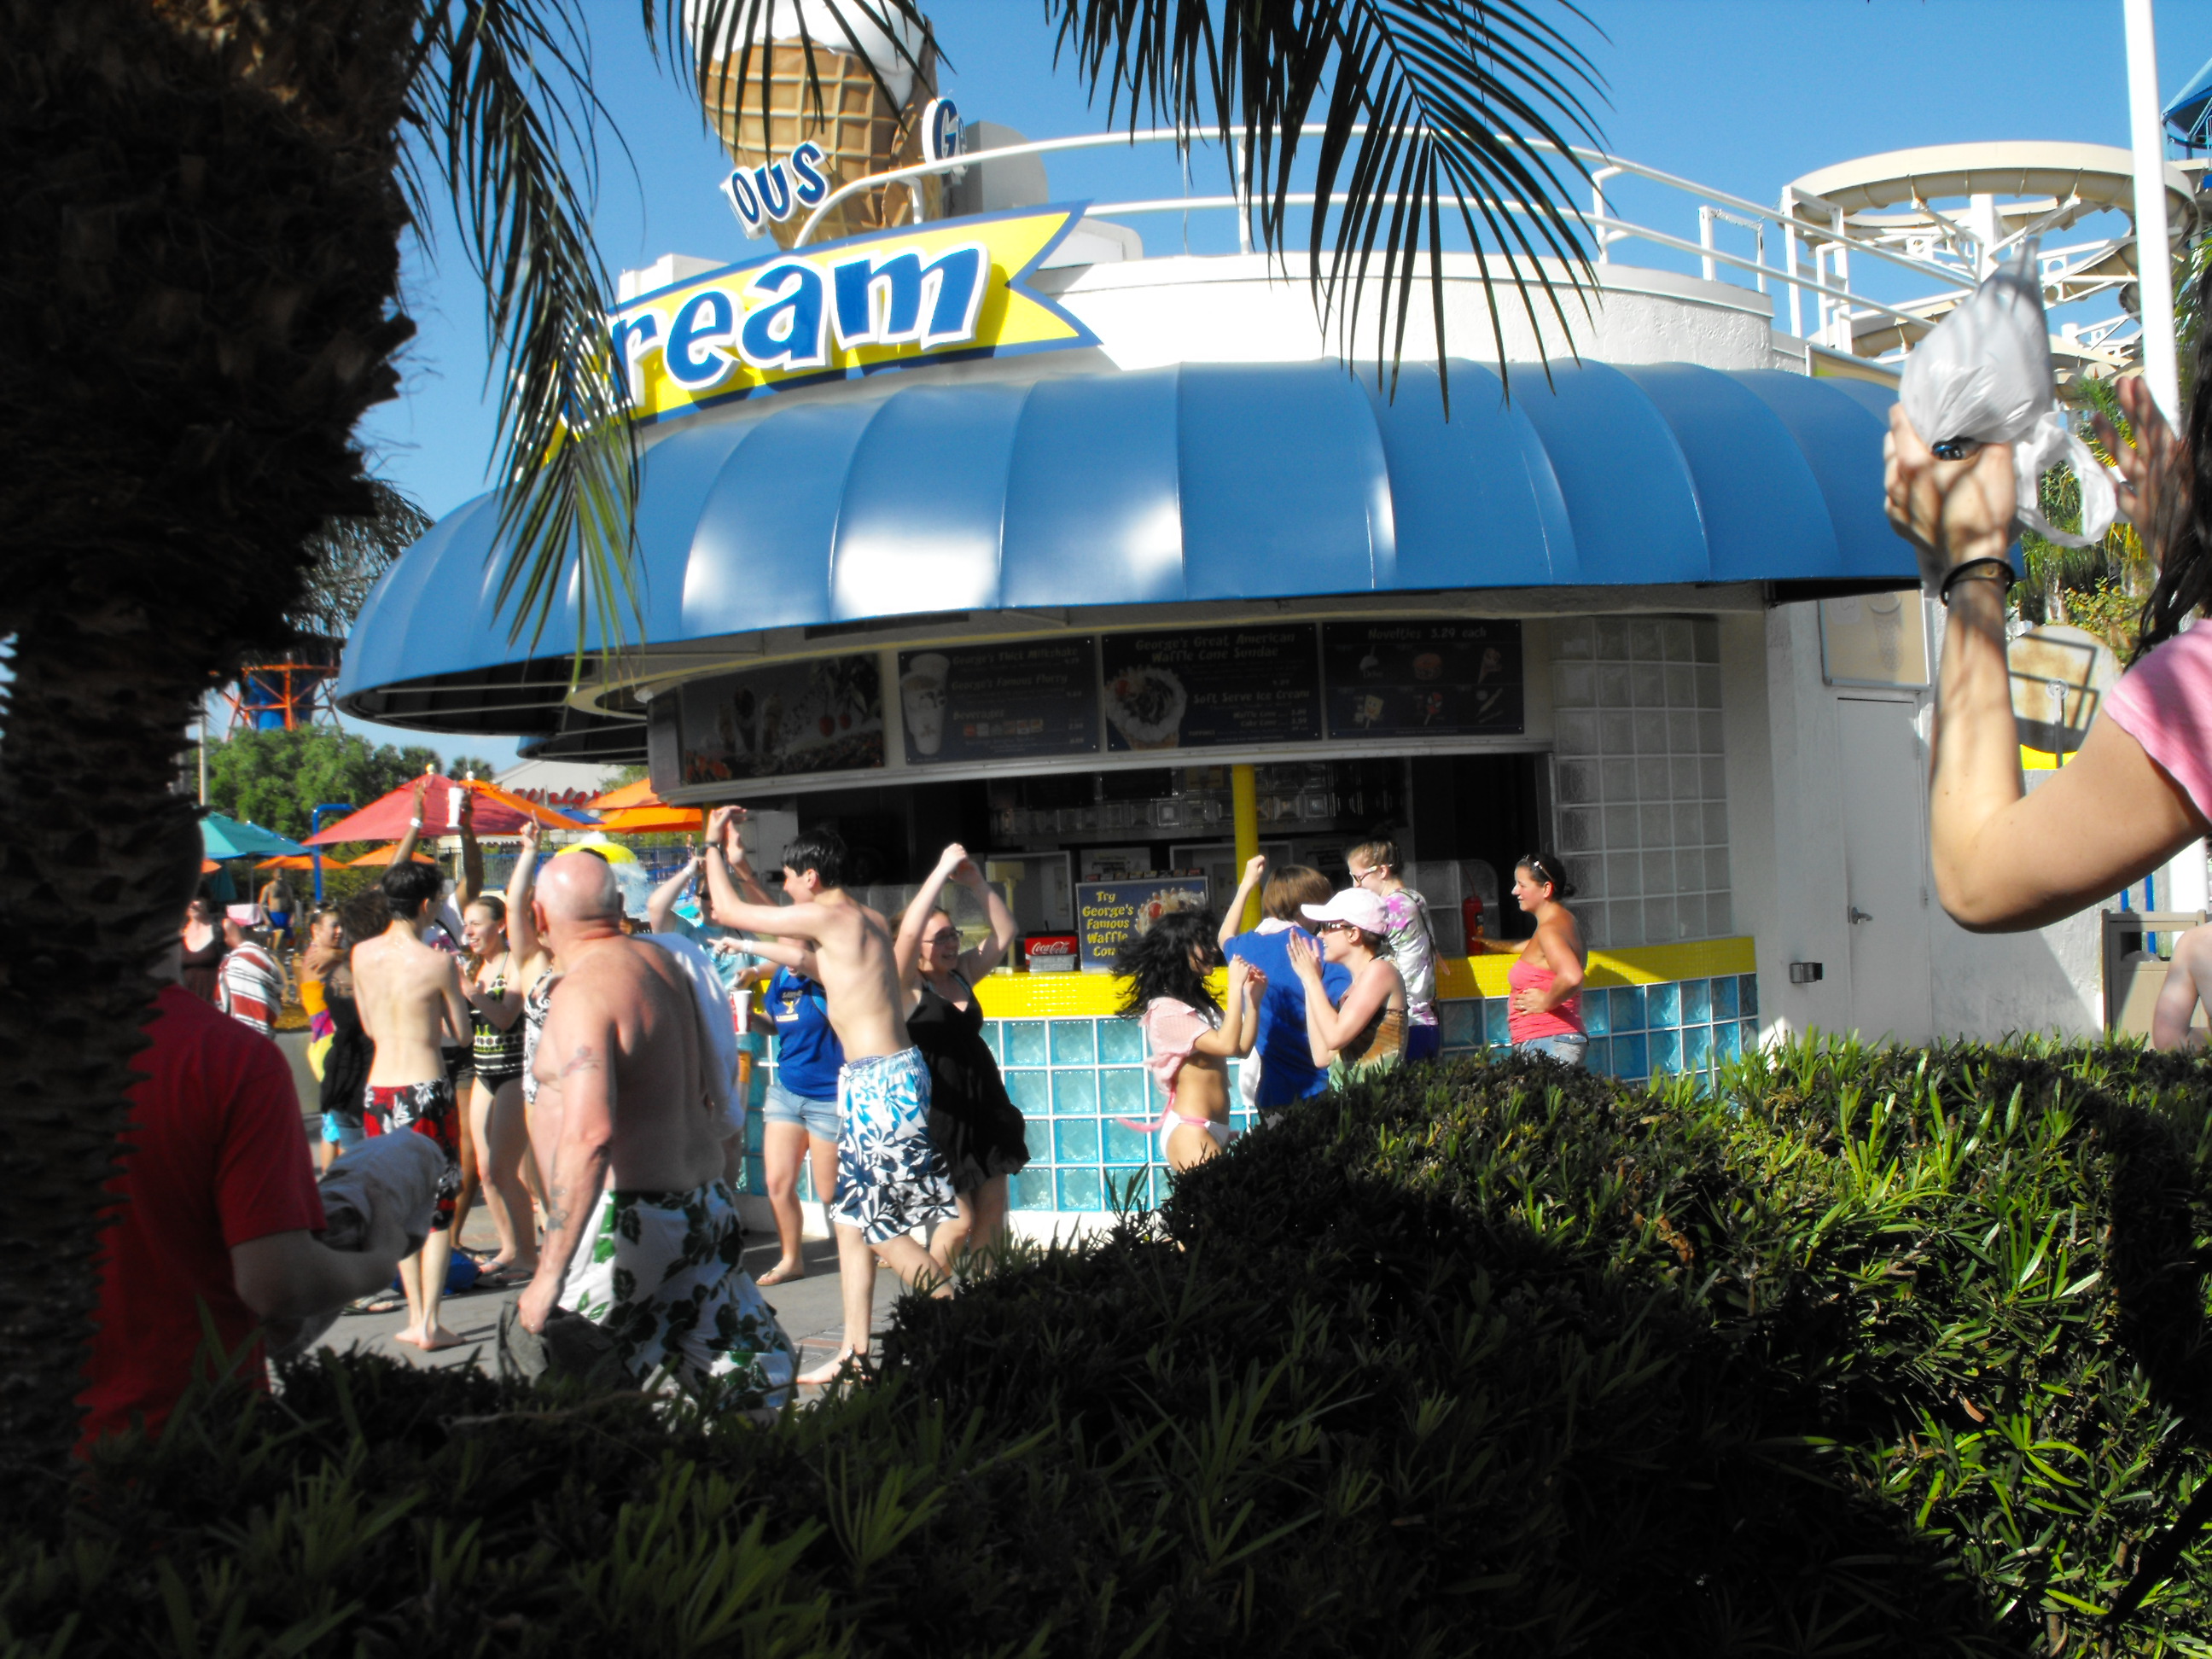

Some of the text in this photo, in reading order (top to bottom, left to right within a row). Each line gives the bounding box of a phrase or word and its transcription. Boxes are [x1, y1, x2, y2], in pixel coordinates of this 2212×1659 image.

[1367, 626, 1487, 640] Novelties 3.29 each
[1135, 632, 1295, 651] George's Great American
[1151, 645, 1279, 663] Waffle Cone Sundae
[1193, 690, 1310, 704] Soft Serve Ice Cream
[512, 787, 601, 806] Walg
[1096, 891, 1116, 903] Try
[1082, 904, 1134, 918] George's
[1086, 918, 1130, 930] Famous
[1086, 931, 1128, 944] Waffle
[1032, 941, 1070, 955] Coca-Cola
[1093, 946, 1118, 957] Con
[1031, 963, 1074, 972] CLOSED
